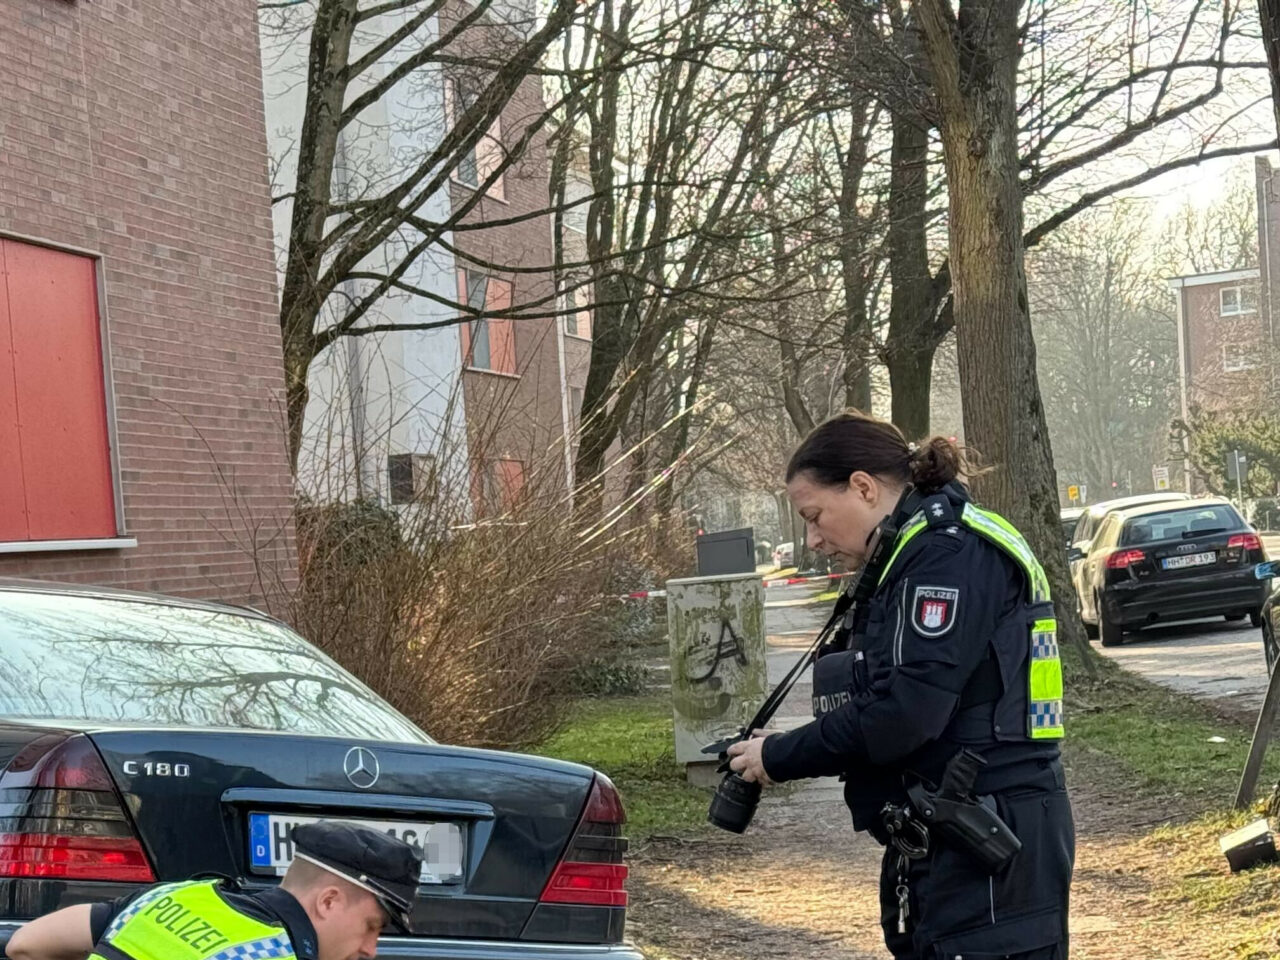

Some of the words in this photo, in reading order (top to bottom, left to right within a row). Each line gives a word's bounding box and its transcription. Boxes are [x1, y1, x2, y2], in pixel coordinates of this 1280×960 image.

[918, 590, 956, 600] POLIZEI
[123, 760, 138, 775] C
[144, 762, 190, 777] 180
[256, 844, 266, 857] D
[144, 896, 230, 954] POLIZEI
